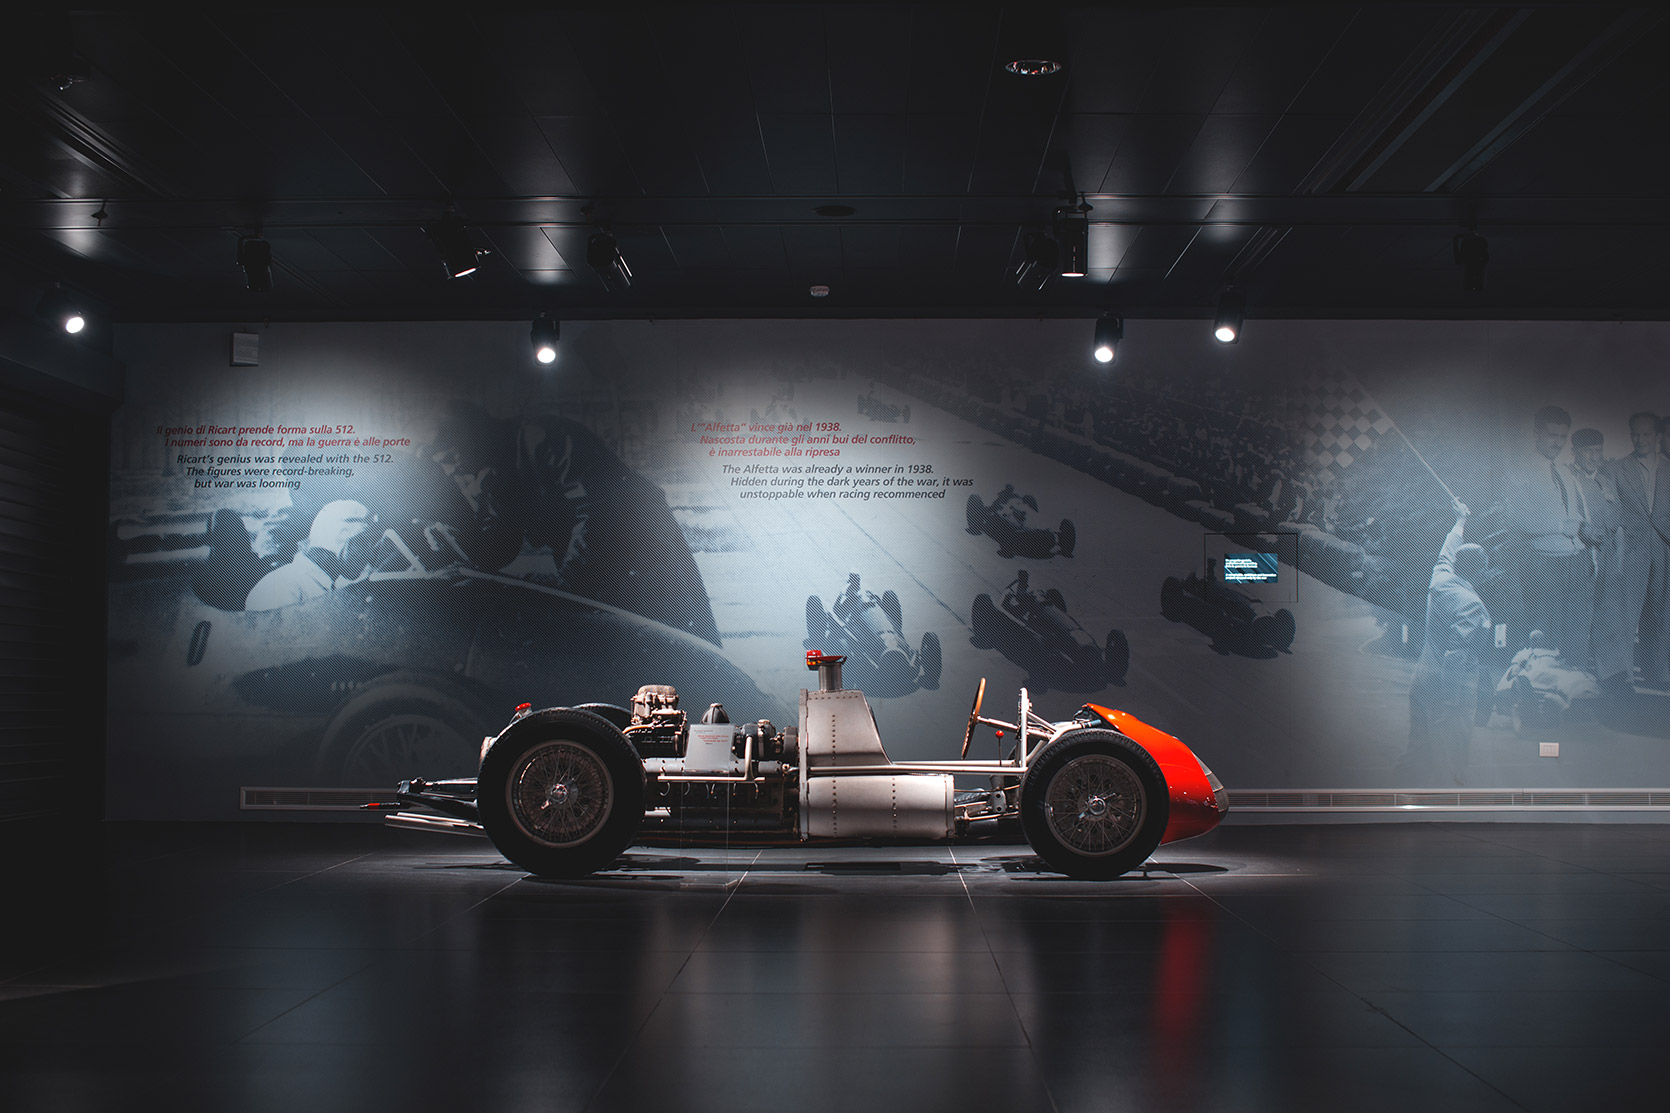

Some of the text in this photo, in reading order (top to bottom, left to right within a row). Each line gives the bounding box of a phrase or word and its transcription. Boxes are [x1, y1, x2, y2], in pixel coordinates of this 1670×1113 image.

[156, 425, 355, 437] Il genio di Ricart prende forma sulla 512.
[749, 423, 775, 432] vince
[777, 423, 793, 434] già
[796, 422, 812, 431] nel
[816, 422, 841, 431] 1938.
[165, 438, 169, 446] I
[171, 438, 207, 446] numeri
[236, 438, 248, 446] da
[251, 438, 285, 447] record,
[306, 437, 315, 446] la
[318, 439, 351, 448] guerra
[354, 437, 360, 446] è
[362, 437, 380, 446] alle
[383, 438, 410, 448] porte
[700, 434, 916, 446] Nascosta durante gli anni bui del conflitto,
[709, 447, 840, 458] è inarrestabile alla ripresa
[217, 455, 251, 465] genius
[278, 454, 323, 463] revealed
[326, 454, 350, 463] with
[353, 454, 370, 463] the
[373, 454, 394, 463] 512.
[186, 467, 204, 476] The
[207, 466, 241, 478] figures
[272, 466, 355, 478] record-breaking,
[722, 464, 741, 474] The
[743, 464, 779, 474] Alfetta
[805, 464, 844, 476] already
[855, 464, 892, 474] winner
[894, 464, 904, 474] in
[908, 464, 934, 474] 1938.
[194, 479, 212, 488] but
[259, 479, 301, 490] looming
[731, 477, 768, 486] Hidden
[770, 477, 804, 488] during
[807, 477, 825, 486] the
[827, 477, 850, 486] dark
[852, 479, 880, 488] years
[883, 477, 894, 486] of
[897, 477, 914, 486] the
[917, 479, 939, 487] war,
[942, 477, 950, 486] it
[740, 489, 946, 500] unstoppable when racing recommenced
